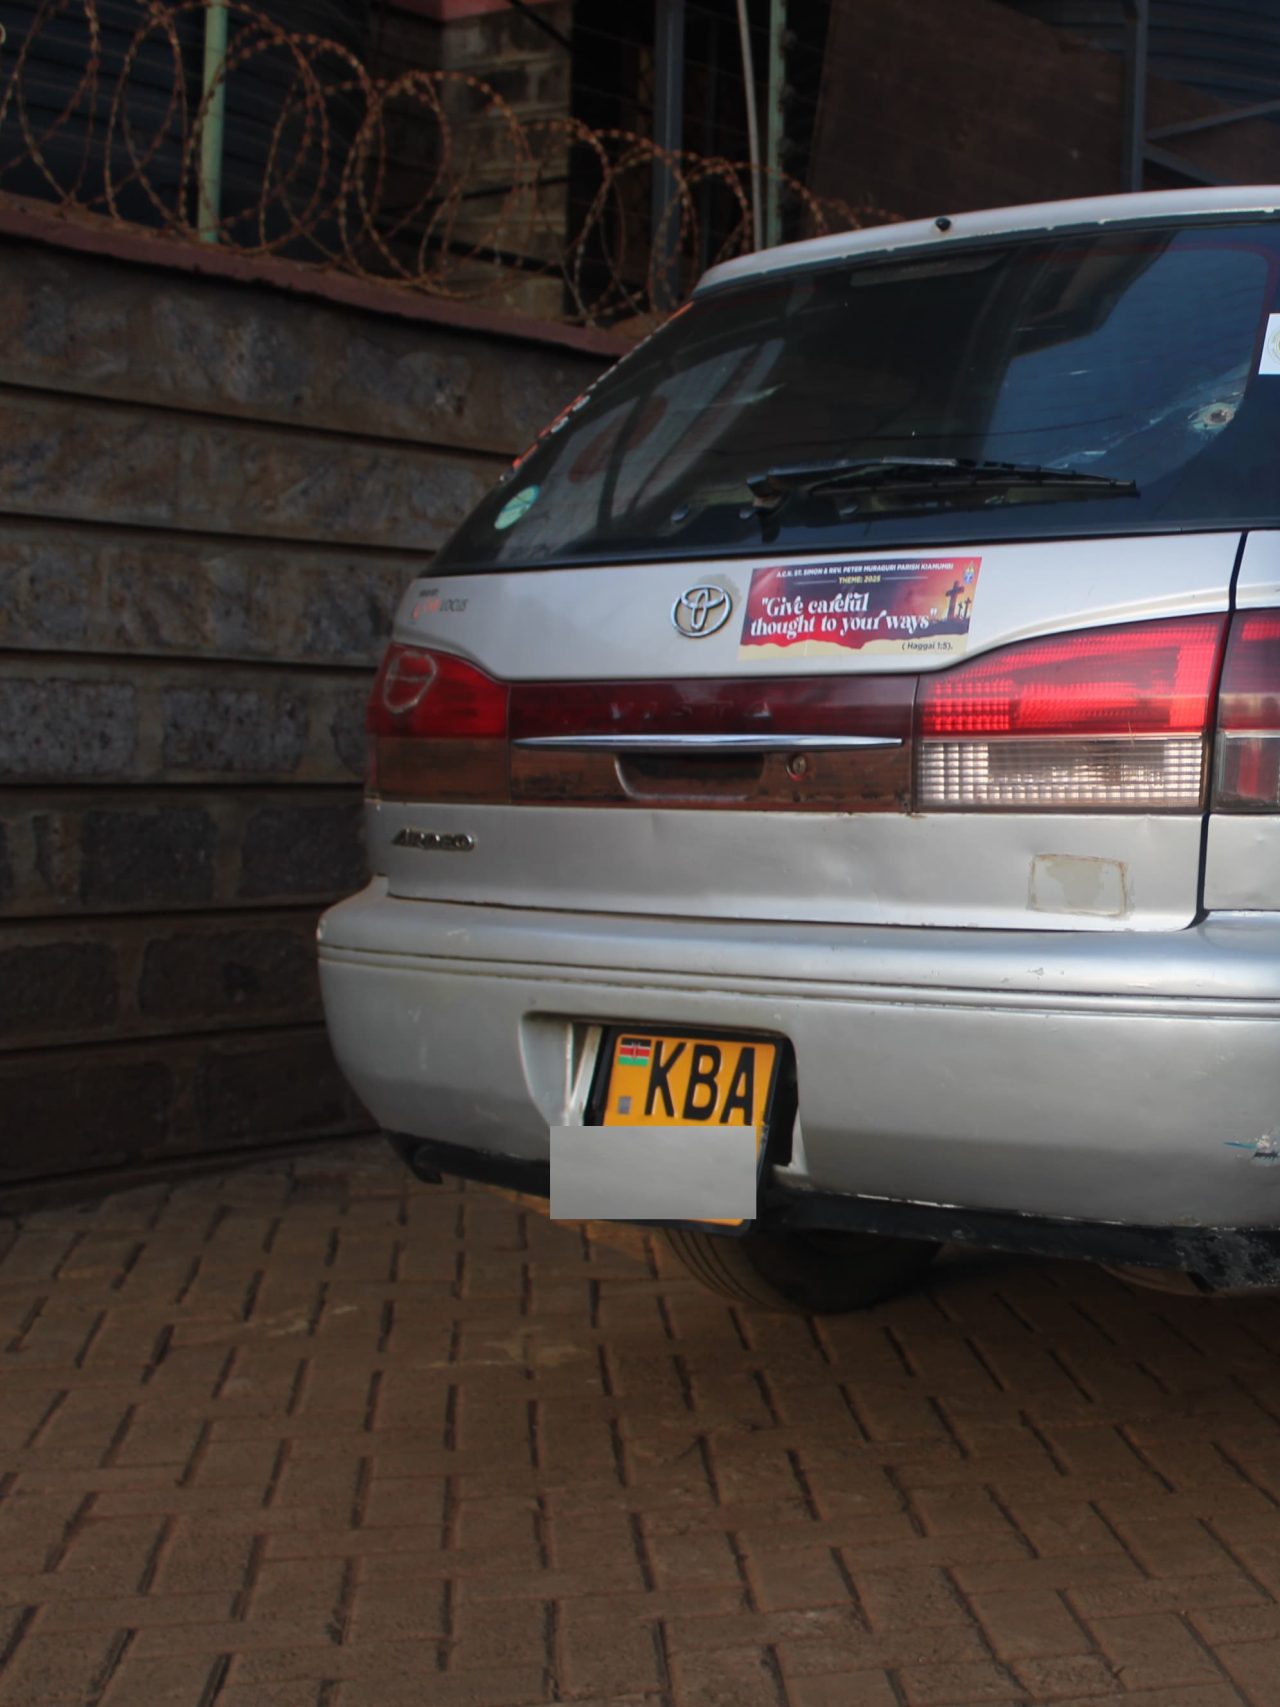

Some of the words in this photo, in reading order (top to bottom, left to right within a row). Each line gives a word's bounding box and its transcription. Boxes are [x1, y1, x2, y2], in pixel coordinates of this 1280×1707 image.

[803, 567, 823, 577] SIMON
[843, 565, 863, 574] PETER
[863, 564, 896, 573] MURAGURI
[896, 563, 920, 572] PARISH
[839, 575, 863, 585] THEME:
[762, 595, 804, 617] "Give
[808, 592, 869, 614] careful
[751, 614, 816, 640] thought
[821, 615, 837, 632] to
[840, 610, 887, 637] your
[886, 607, 938, 635] ways"
[907, 642, 935, 651] Haggai
[644, 1040, 756, 1126] KBA
